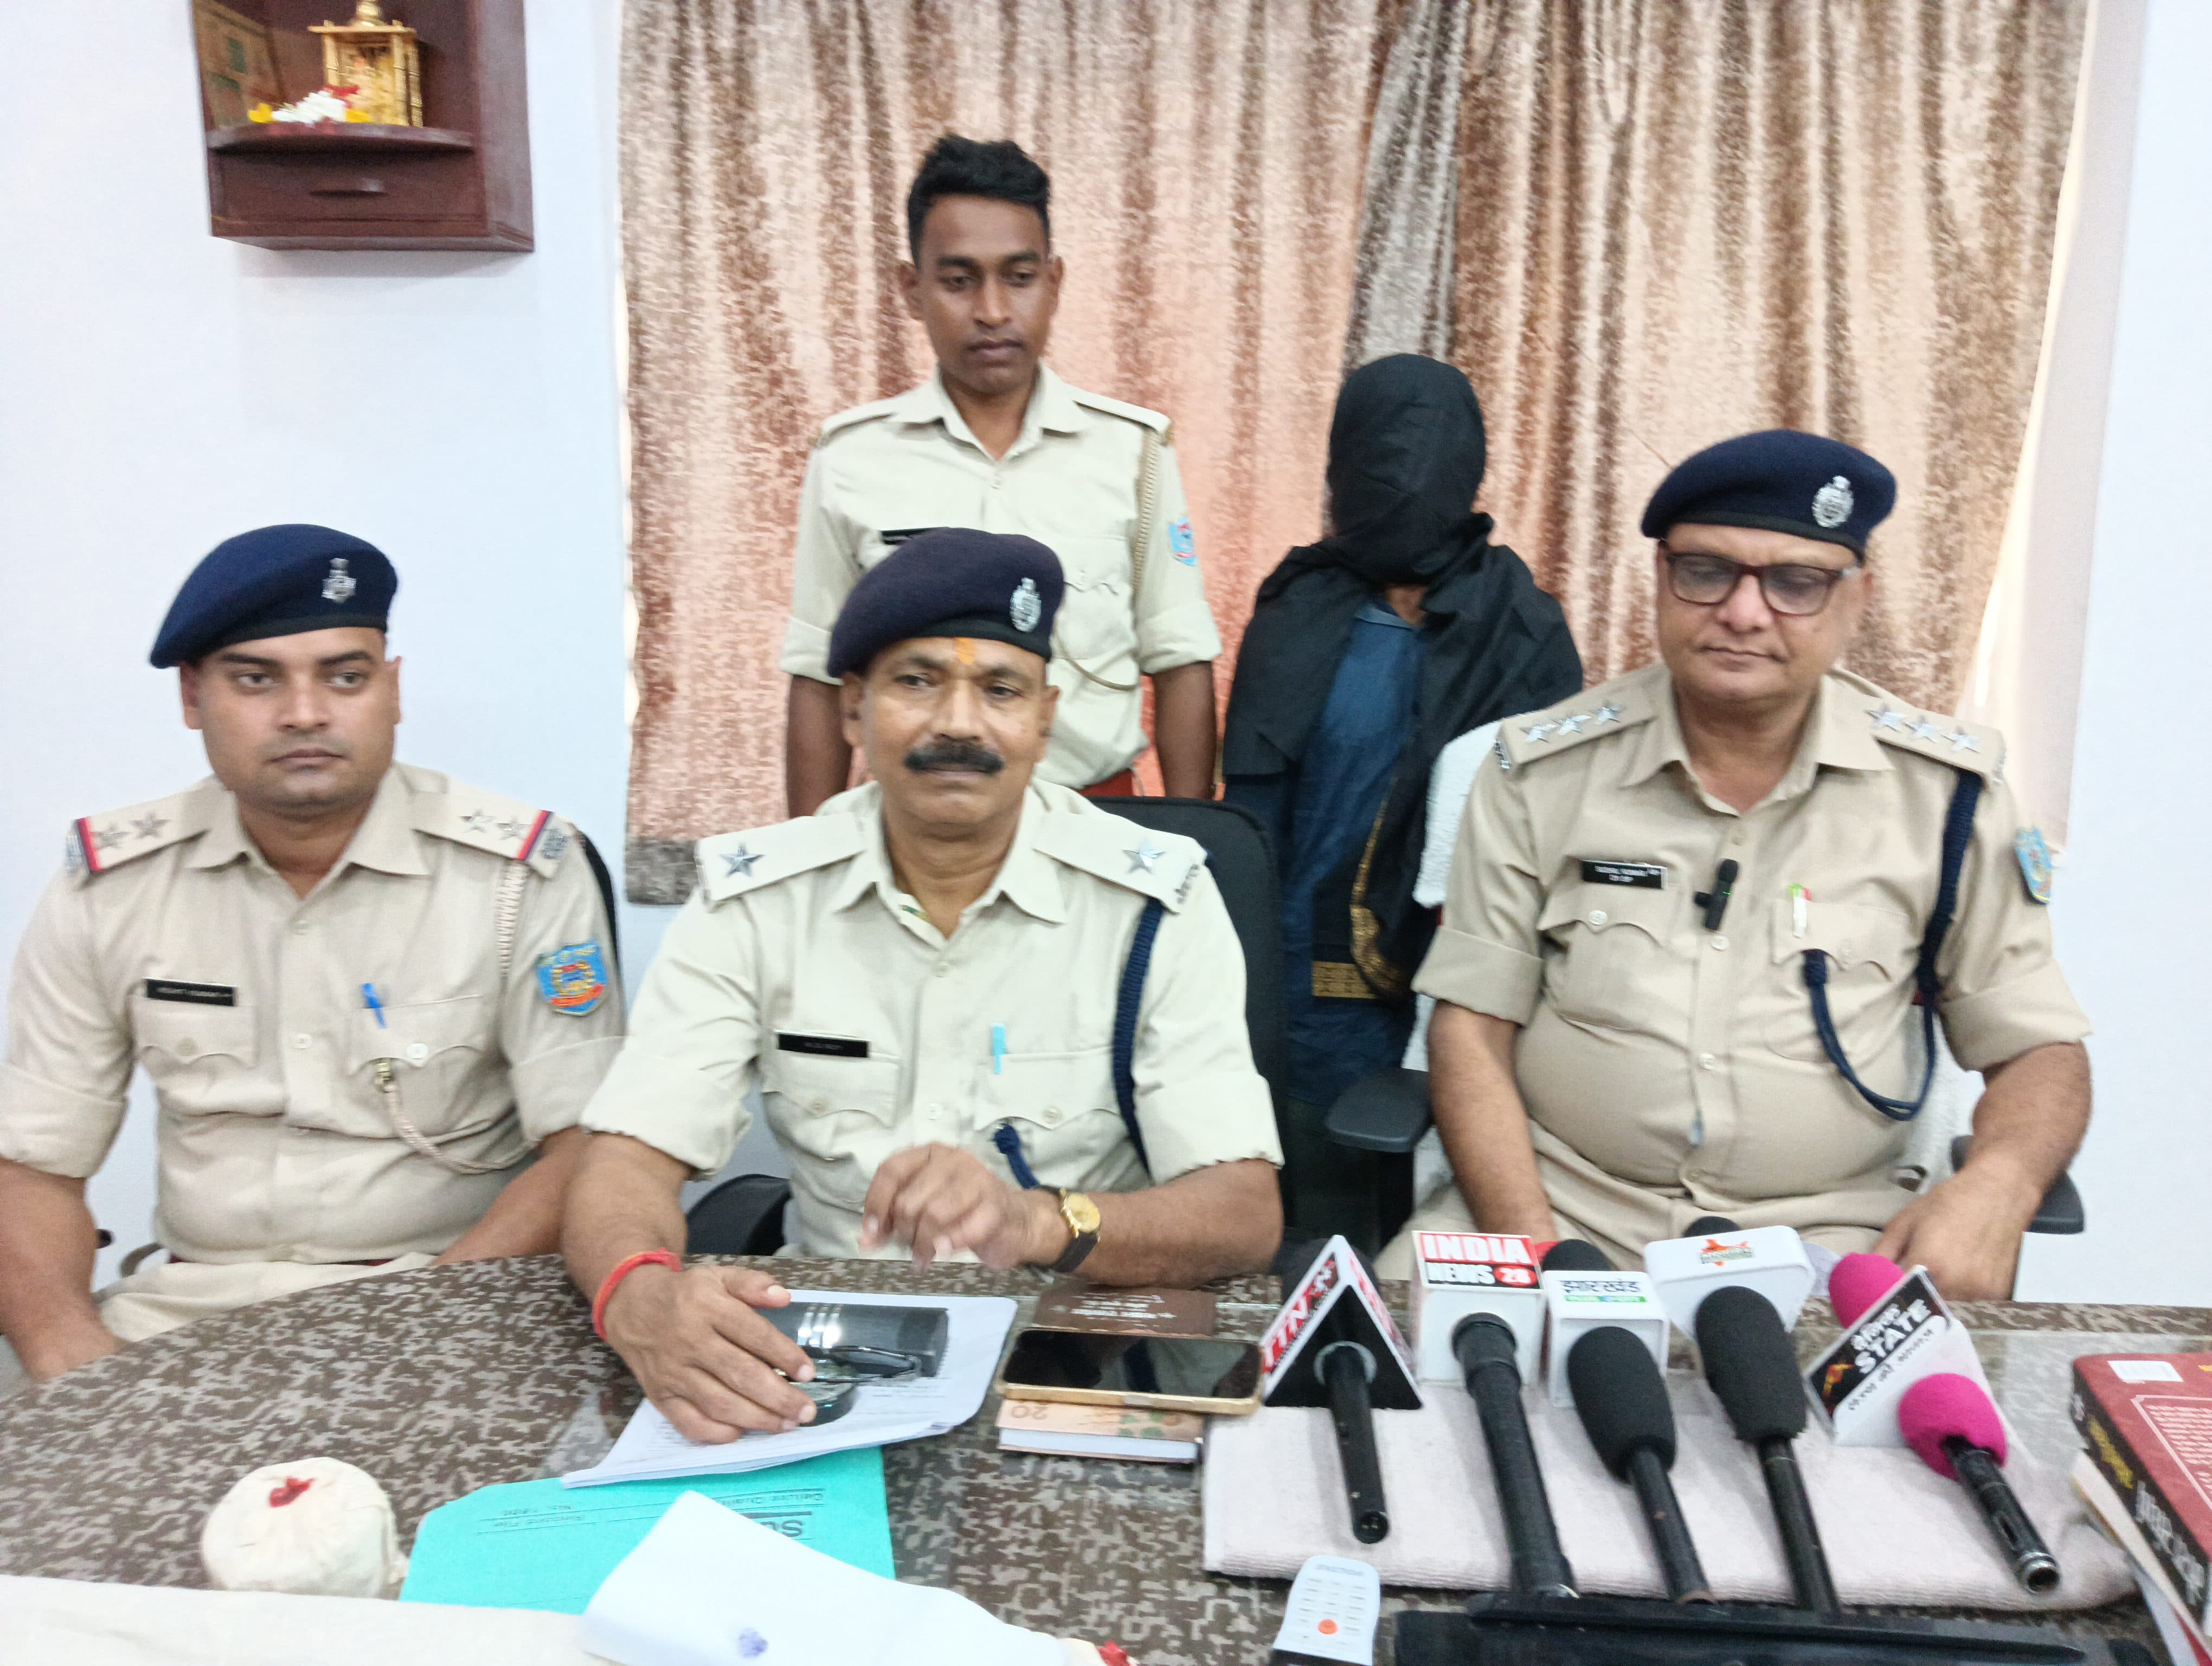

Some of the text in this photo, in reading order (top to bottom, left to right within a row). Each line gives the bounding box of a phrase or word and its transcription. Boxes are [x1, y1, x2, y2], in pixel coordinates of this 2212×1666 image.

[1421, 1234, 1532, 1264] INDIA
[1426, 1261, 1496, 1284] NEWS
[1854, 1299, 1931, 1374] STATE
